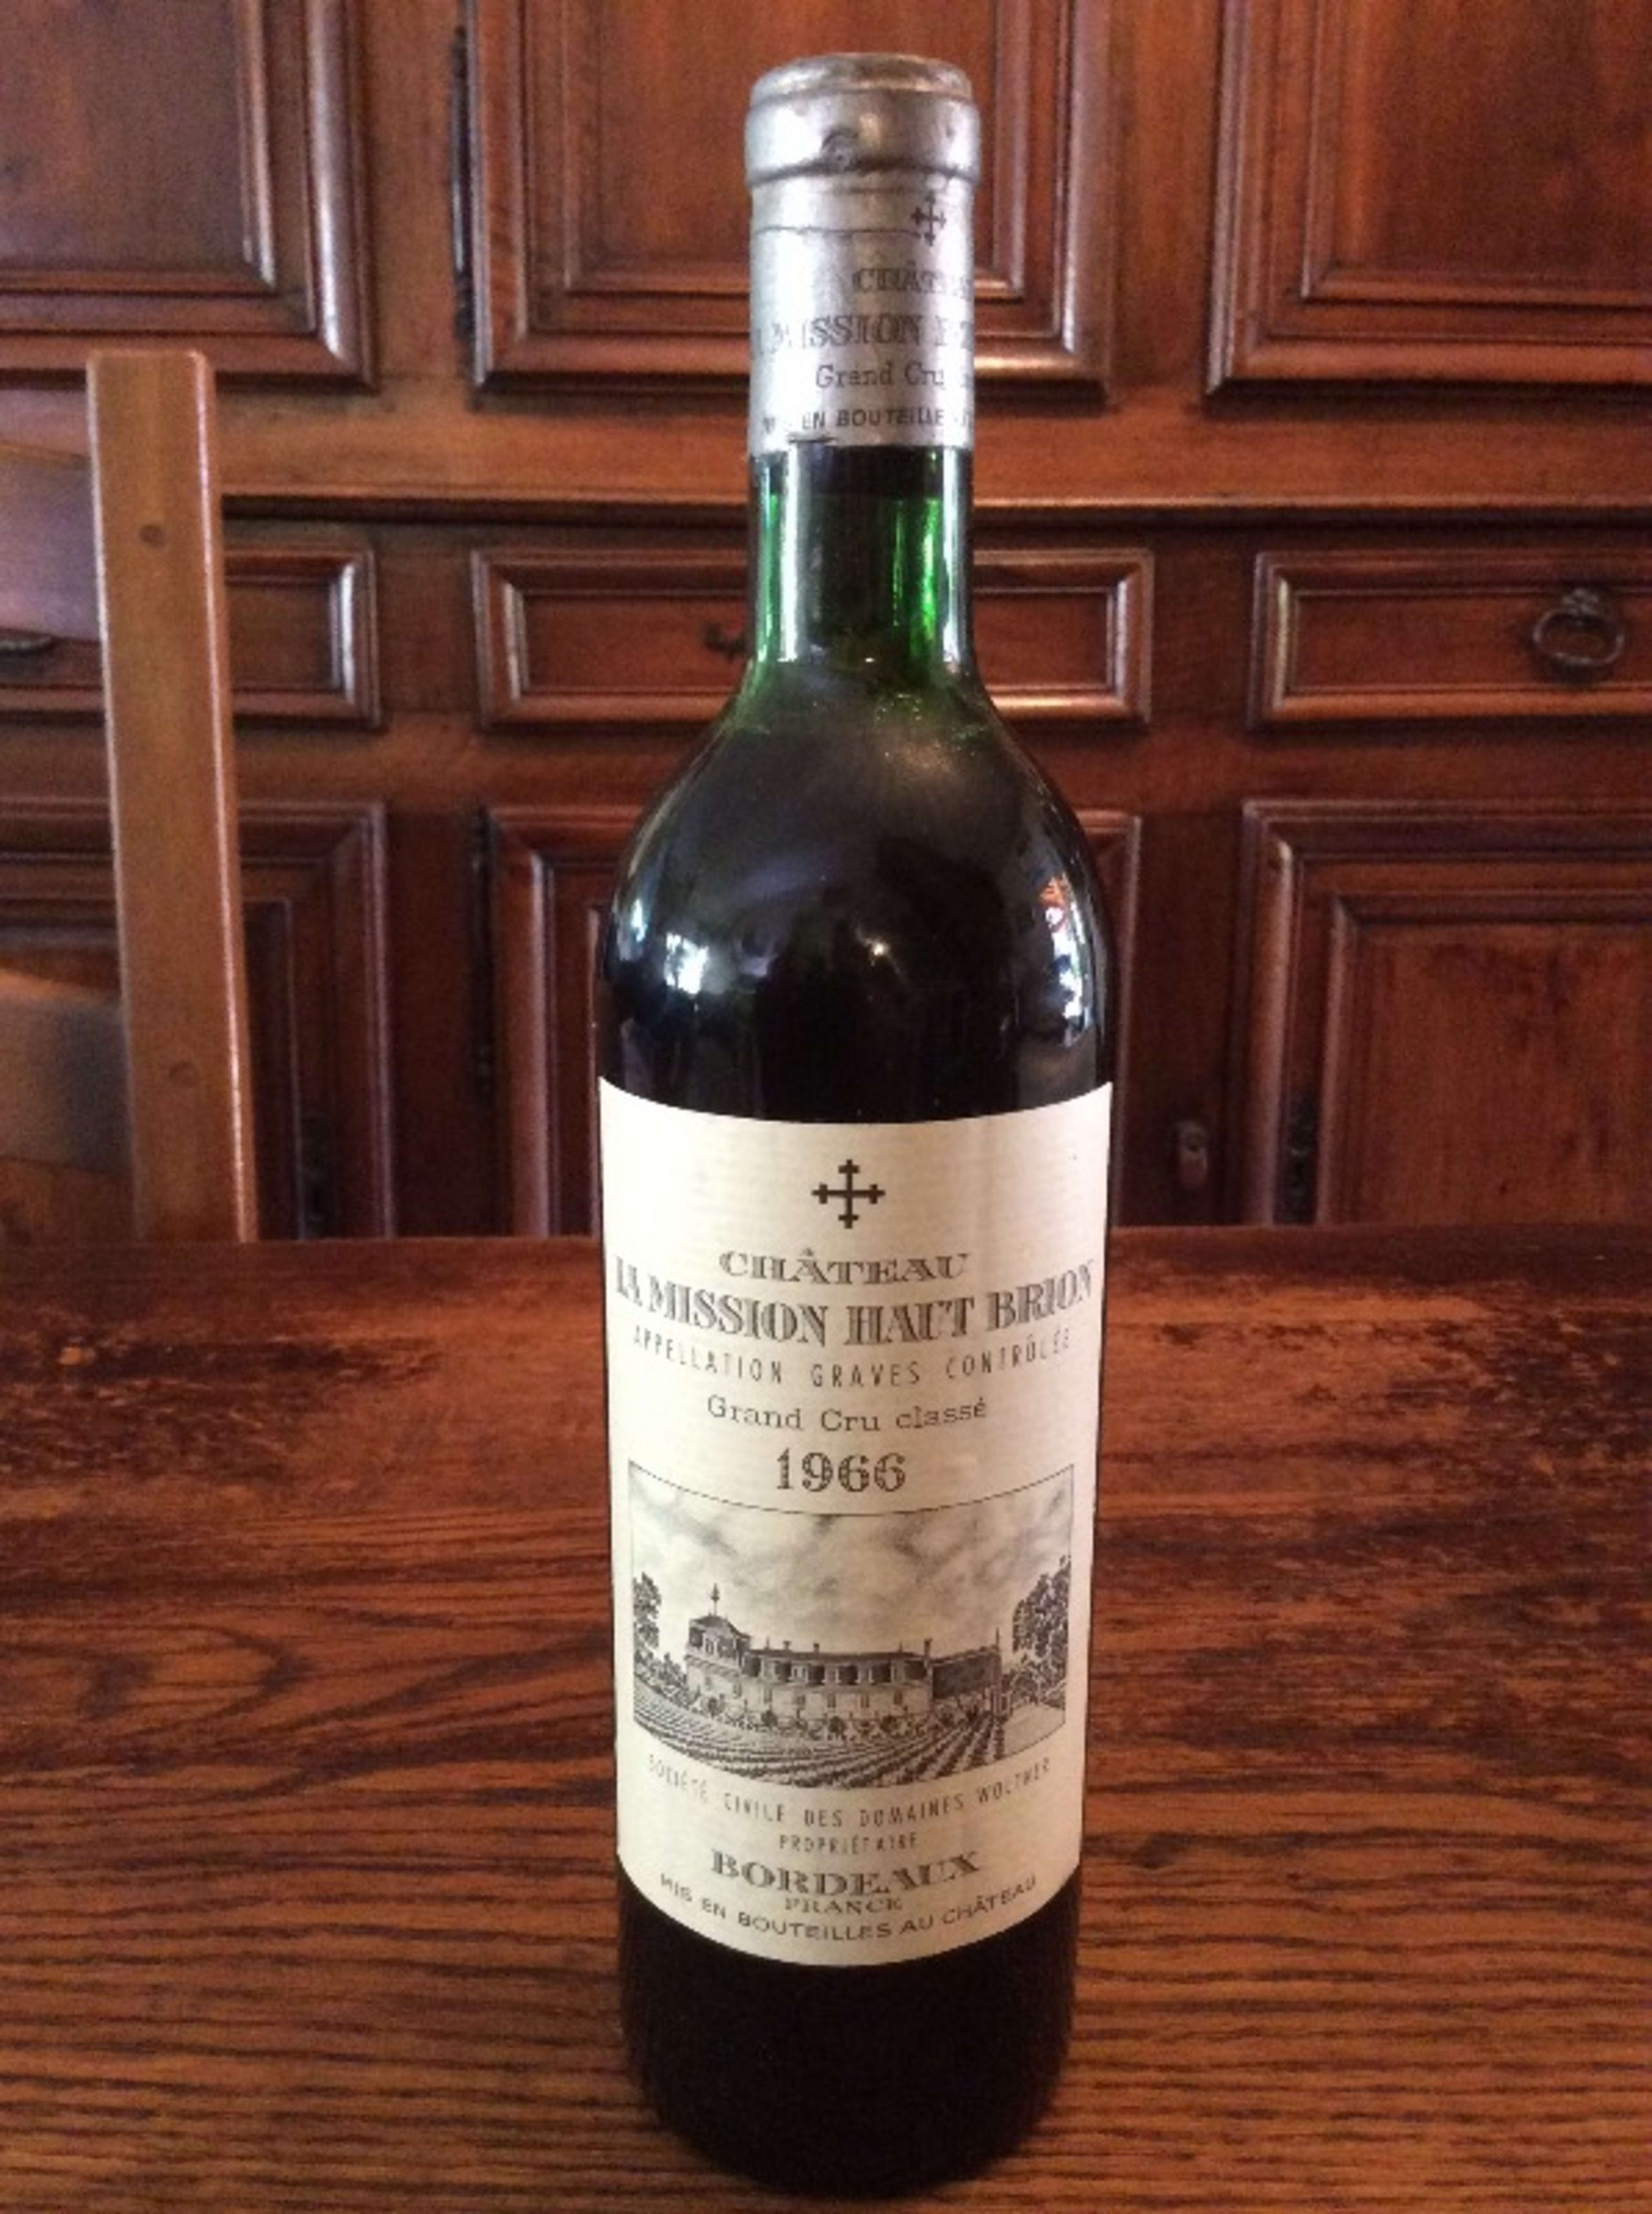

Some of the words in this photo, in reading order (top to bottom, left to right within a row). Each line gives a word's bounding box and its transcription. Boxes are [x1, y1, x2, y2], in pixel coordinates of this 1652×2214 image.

[816, 359, 894, 389] Grand
[719, 1248, 969, 1285] CHÂTEAU
[616, 1256, 643, 1307] LA
[648, 1274, 829, 1347] MISSION
[843, 1296, 975, 1346] HAUT
[985, 1259, 1094, 1332] BRION
[633, 1325, 782, 1385] APPELLATION
[811, 1360, 921, 1388] GRAVES
[707, 1394, 803, 1431] Grand
[821, 1408, 880, 1432] Cru
[896, 1397, 987, 1429] classé
[776, 1448, 906, 1493] 1966
[724, 1793, 785, 1823] CIVILE
[804, 1809, 842, 1828] DES
[860, 1793, 964, 1827] DOMAINES
[711, 1847, 980, 1896] BORDEAUX
[661, 1873, 693, 1903] MIS
[701, 1898, 727, 1919] EN
[738, 1911, 892, 1941] BOUTEILLES
[900, 1916, 934, 1935] AU
[941, 1873, 1036, 1925] CHÂTEAU
[785, 1896, 903, 1915] FRANCE
